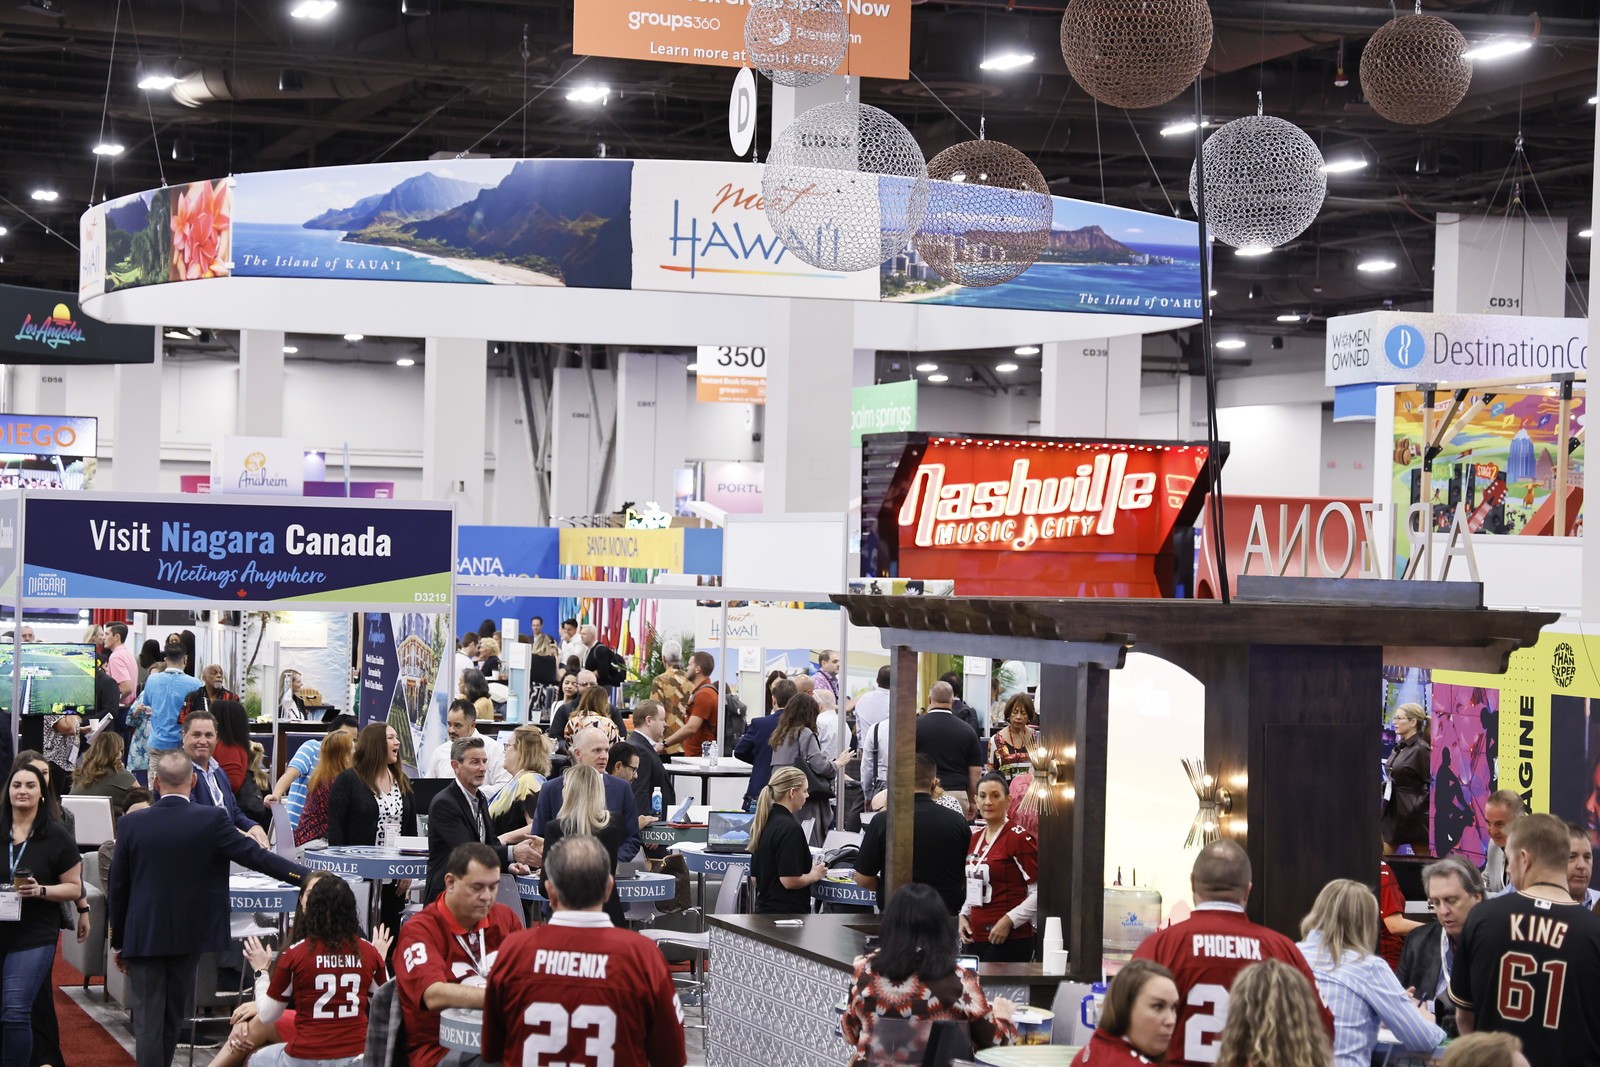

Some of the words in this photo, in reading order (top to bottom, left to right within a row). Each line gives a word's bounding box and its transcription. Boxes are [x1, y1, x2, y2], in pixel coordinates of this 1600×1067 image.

[628, 10, 721, 31] groups360
[650, 41, 689, 57] Learn
[693, 47, 729, 60] more
[732, 49, 747, 61] at
[737, 88, 750, 133] D
[243, 254, 268, 266] The
[275, 255, 318, 268] Island
[325, 257, 339, 271] of
[1080, 293, 1099, 304] The
[1105, 294, 1139, 306] Island
[1145, 297, 1157, 309] of
[1490, 298, 1520, 308] CD31
[35, 316, 86, 349] Angeles
[717, 346, 766, 368] 350
[1332, 350, 1370, 371] OWNED
[875, 401, 911, 432] springs
[238, 467, 288, 488] Anaheim
[717, 483, 762, 494] PORTL
[898, 453, 1156, 547] Nashville
[90, 519, 151, 551] Visit
[161, 521, 275, 559] Niagara
[285, 523, 391, 557] Canada
[934, 520, 1017, 546] MUSIC
[1040, 516, 1096, 538] CITY
[586, 536, 606, 556] SANTA
[608, 537, 639, 557] MONICA
[156, 559, 238, 589] Meetings
[240, 560, 327, 590] Anywhere
[28, 577, 67, 596] NIAGARA
[414, 592, 447, 602] D3219
[1553, 652, 1575, 667] THAN
[1556, 642, 1574, 656] MORE
[1551, 665, 1576, 678] EXPER
[642, 830, 675, 841] TUCSON
[1510, 913, 1568, 949] KING
[404, 941, 428, 973] 23
[1192, 934, 1262, 960] PHOENIX
[316, 954, 362, 969] PHOENIX
[533, 949, 609, 979] PHOENIX
[313, 973, 361, 1019] 23
[1497, 951, 1567, 1029] 61
[522, 1002, 617, 1067] 23
